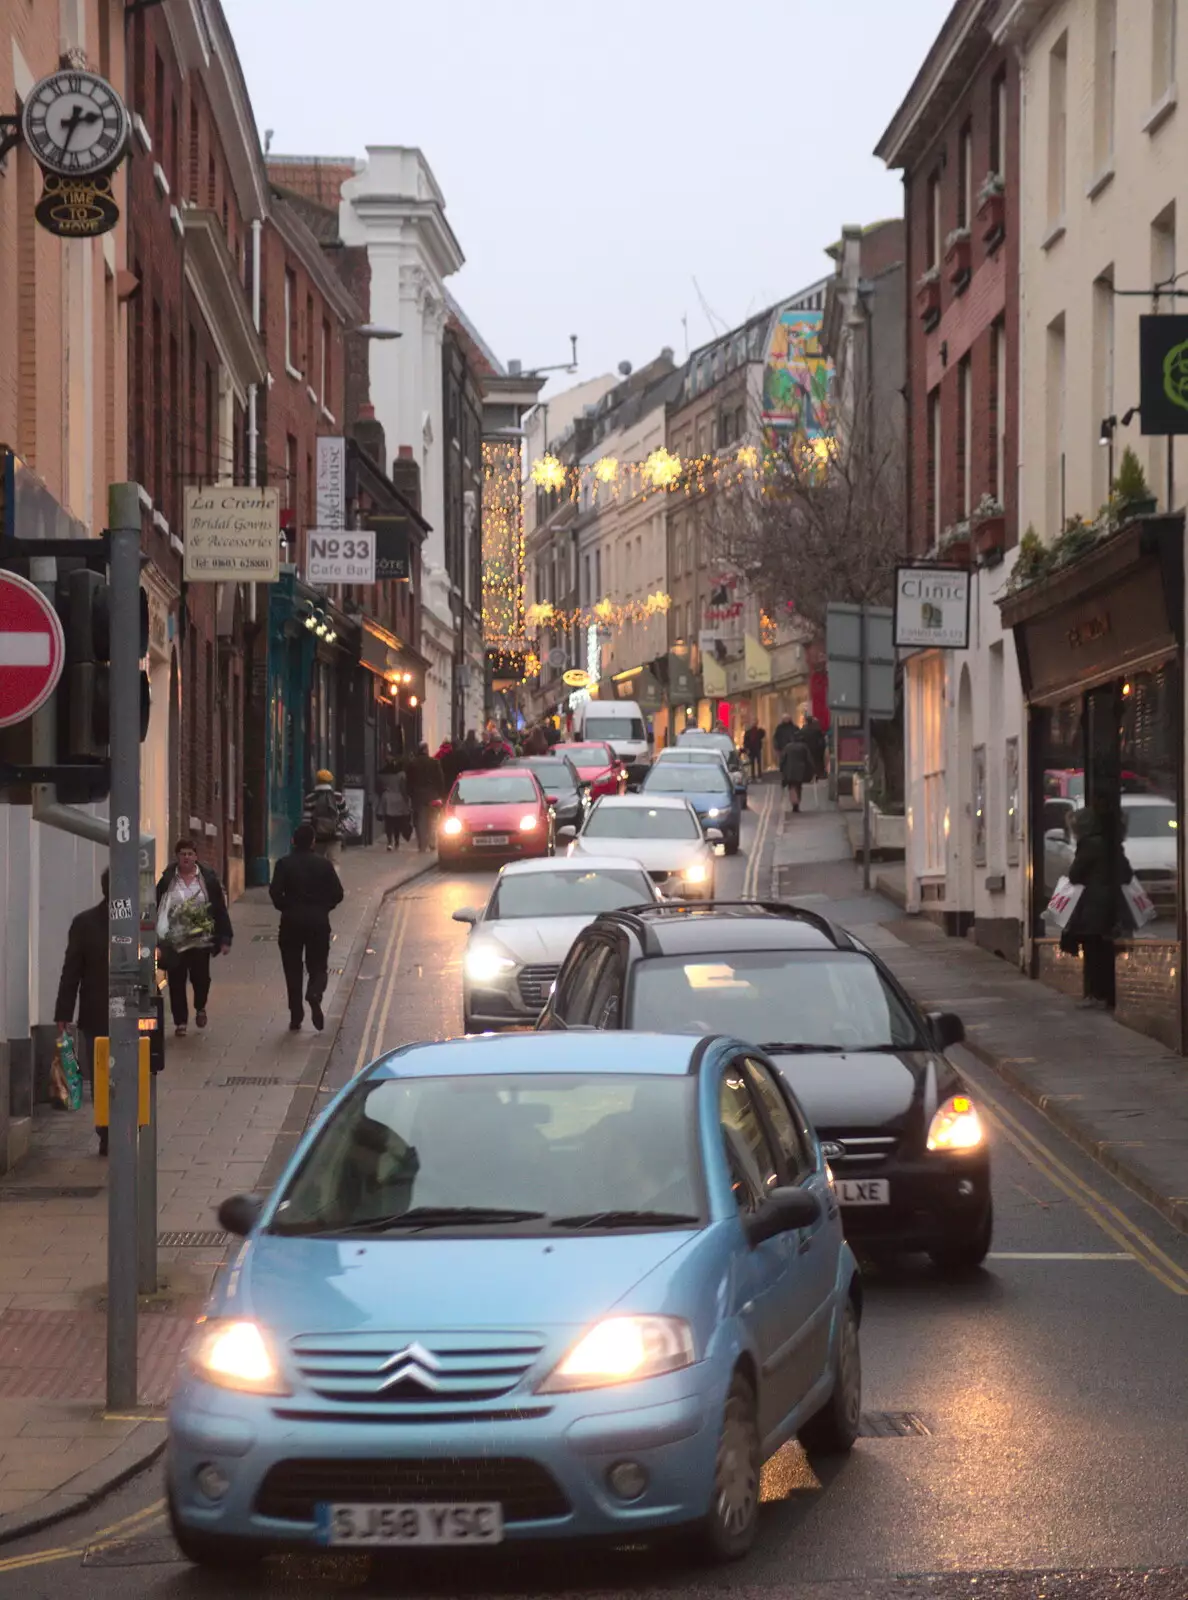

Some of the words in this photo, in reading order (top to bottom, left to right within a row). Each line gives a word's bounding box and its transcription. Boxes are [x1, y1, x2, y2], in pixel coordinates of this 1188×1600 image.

[63, 191, 94, 205] TIME
[68, 207, 88, 220] TO
[324, 446, 340, 531] okehouse
[190, 497, 214, 510] La
[192, 514, 235, 530] Bridal
[234, 519, 272, 533] Gowns
[208, 534, 273, 548] Accessories
[310, 563, 342, 576] Cafe
[346, 563, 370, 576] Bar
[901, 579, 965, 600] Clinic
[116, 815, 131, 843] 8
[842, 1182, 881, 1202] LXE
[333, 1507, 419, 1539] SJ58
[429, 1506, 494, 1538] YSC
